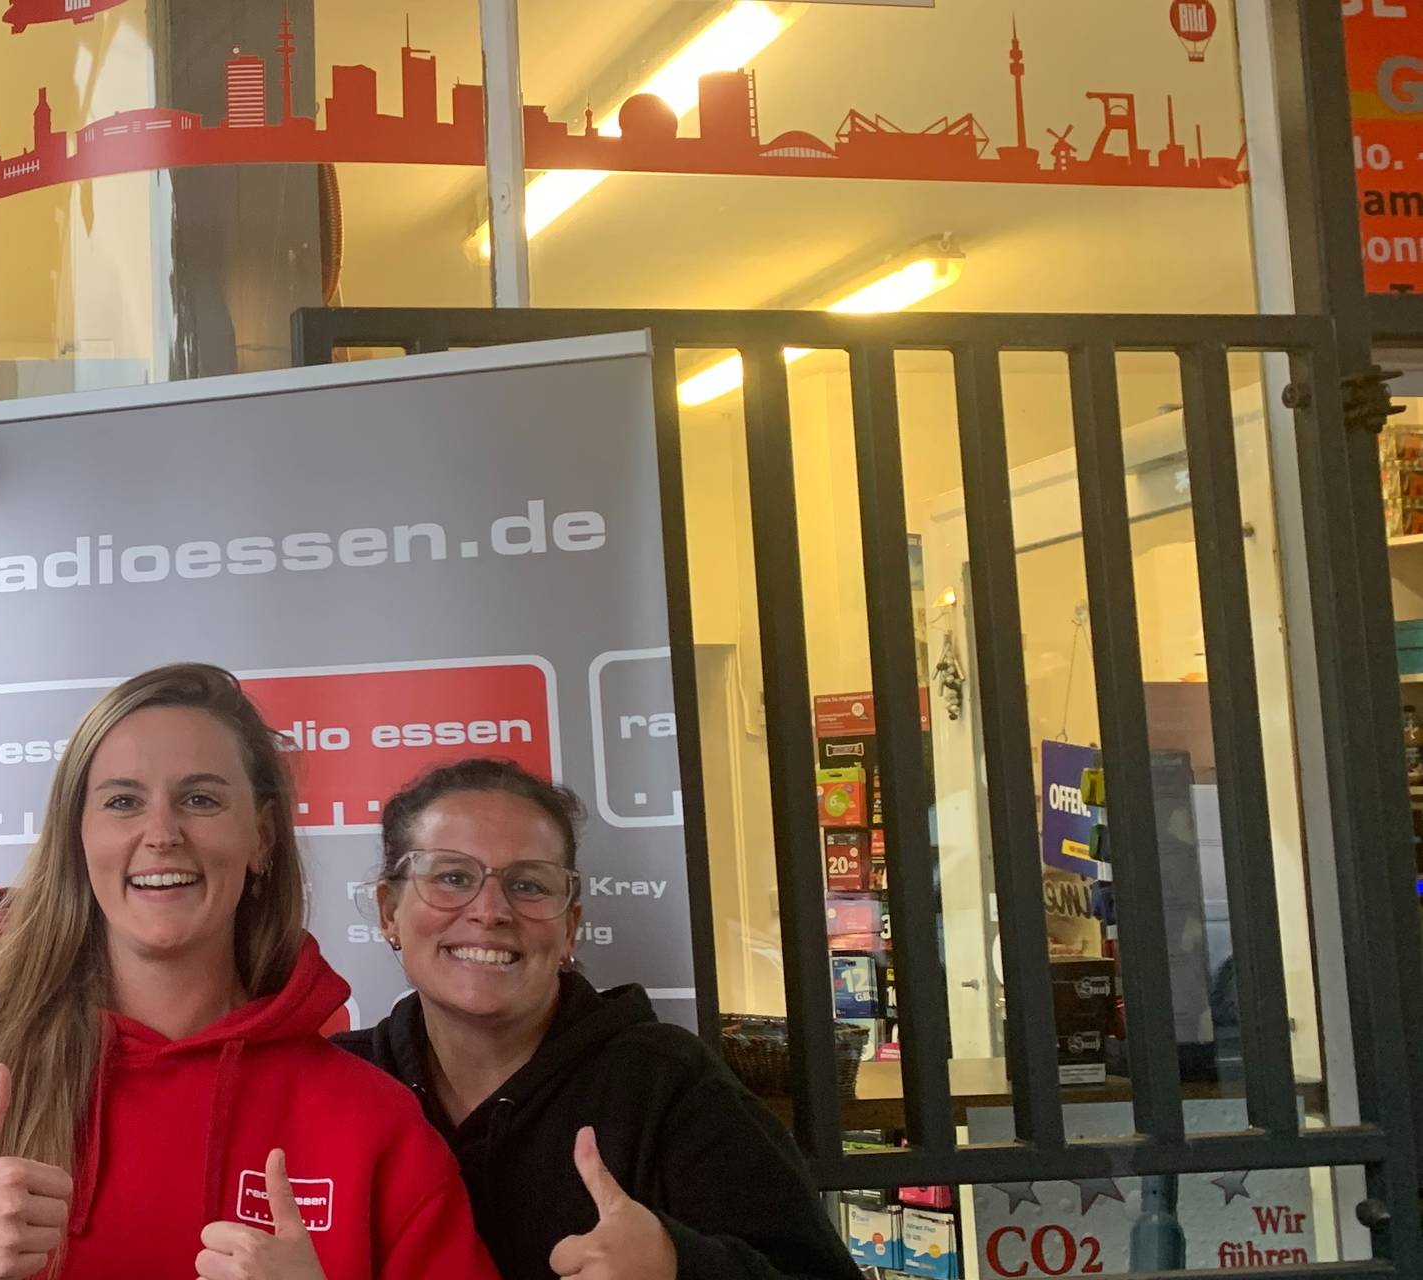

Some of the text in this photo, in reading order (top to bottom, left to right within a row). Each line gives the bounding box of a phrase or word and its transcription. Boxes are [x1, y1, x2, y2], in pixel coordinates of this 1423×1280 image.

[1178, 4, 1208, 32] Bild
[1362, 235, 1423, 263] on
[274, 719, 532, 752] dio essen
[620, 712, 677, 740] ra
[590, 876, 667, 899] Kray
[841, 968, 871, 993] 12
[1252, 1206, 1306, 1234] Wir
[986, 1223, 1104, 1278] CO2
[1218, 1241, 1308, 1268] führen
